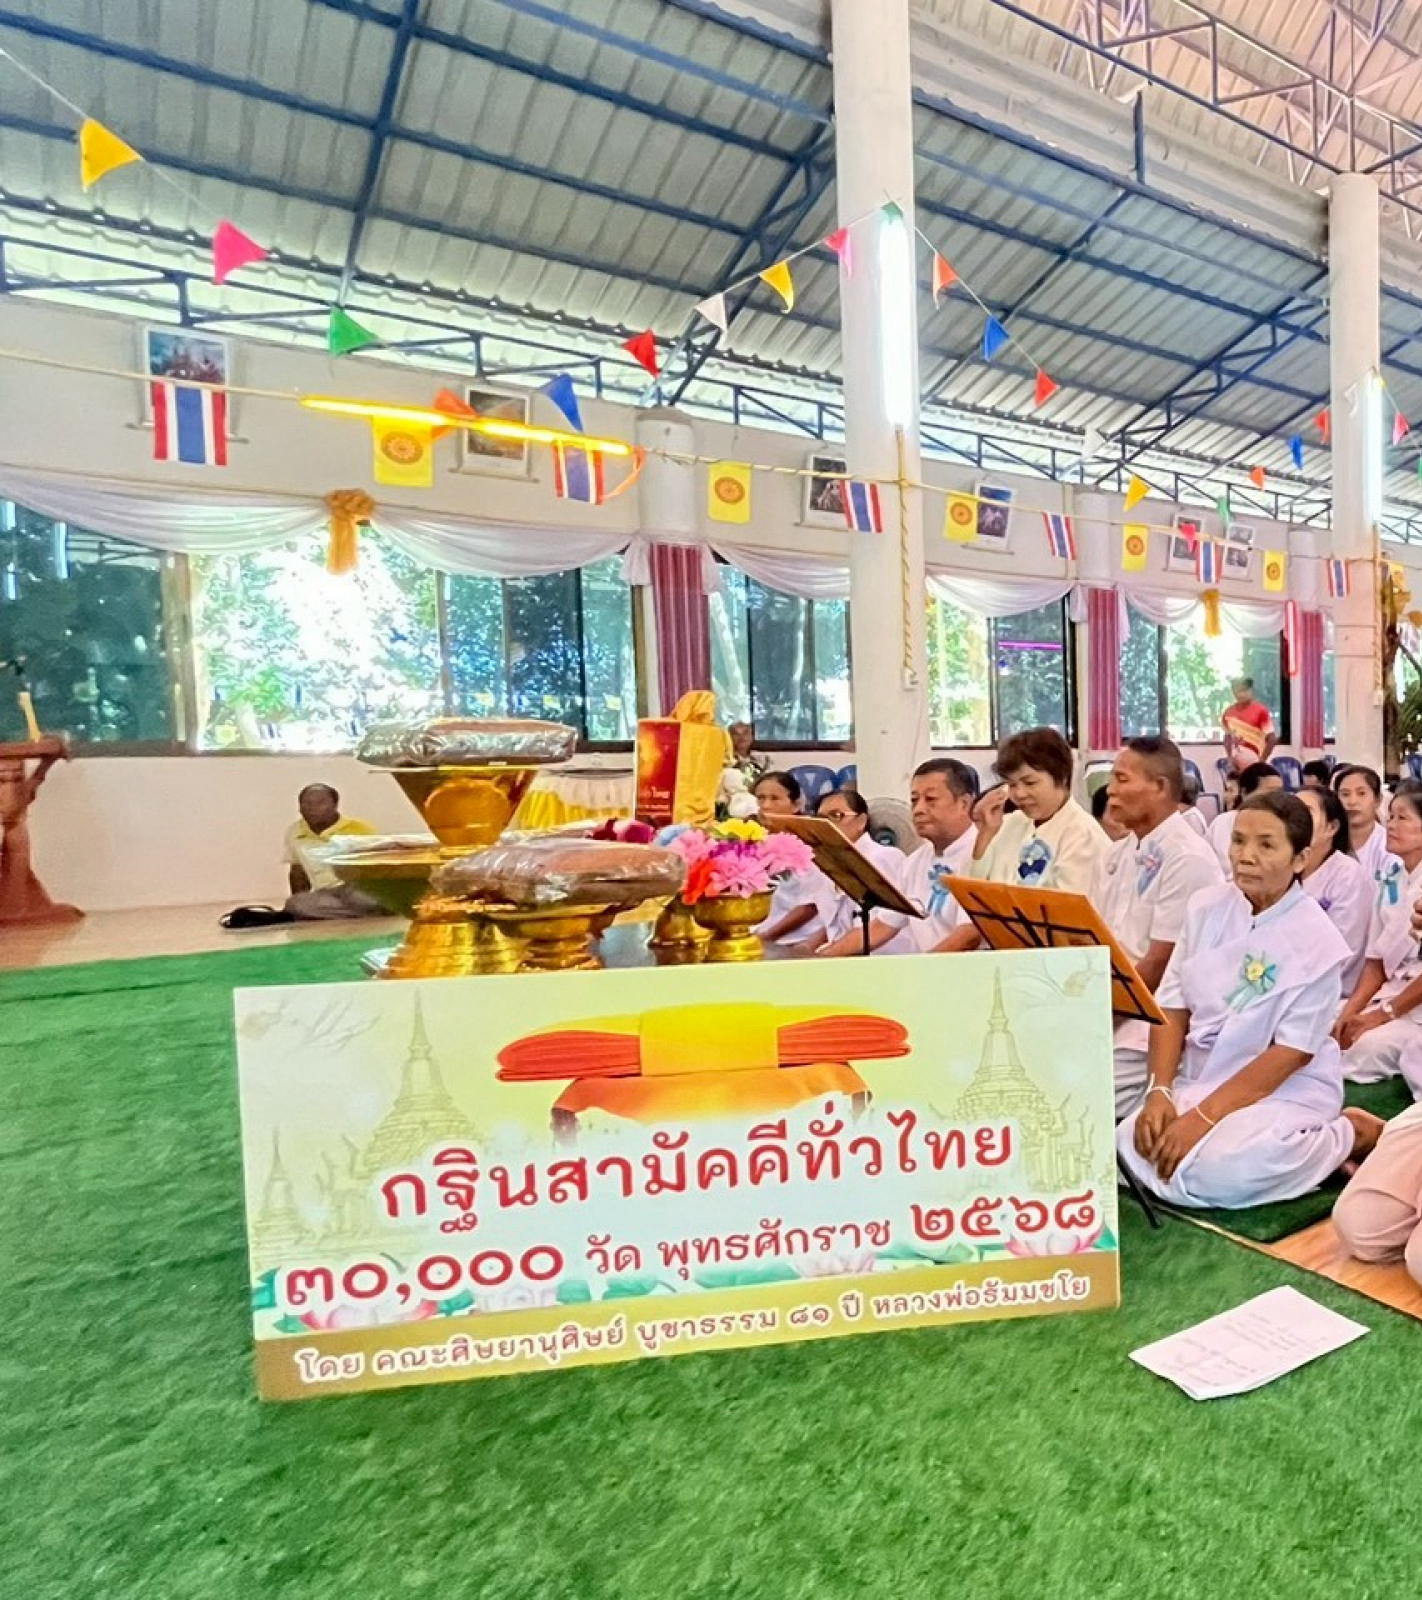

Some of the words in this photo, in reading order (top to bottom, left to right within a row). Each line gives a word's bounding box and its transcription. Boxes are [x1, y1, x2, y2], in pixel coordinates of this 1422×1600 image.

[381, 1101, 1012, 1233] กฐินสามัคคีทั่วไทย
[286, 1245, 563, 1305] ๓๐,๐๐๐
[586, 1234, 641, 1274] วัด
[658, 1218, 892, 1281] พุทธศักราช
[911, 1189, 1096, 1241] ๒๕๖๘
[300, 1353, 361, 1379] โดย
[377, 1317, 624, 1373] คณะศิษยานุศิษย์
[638, 1312, 777, 1350] บูชาธรรม
[790, 1306, 829, 1325] ๘๑
[842, 1293, 861, 1319] ปี
[875, 1272, 1089, 1315] หลวงพ่อธัมมชโย
